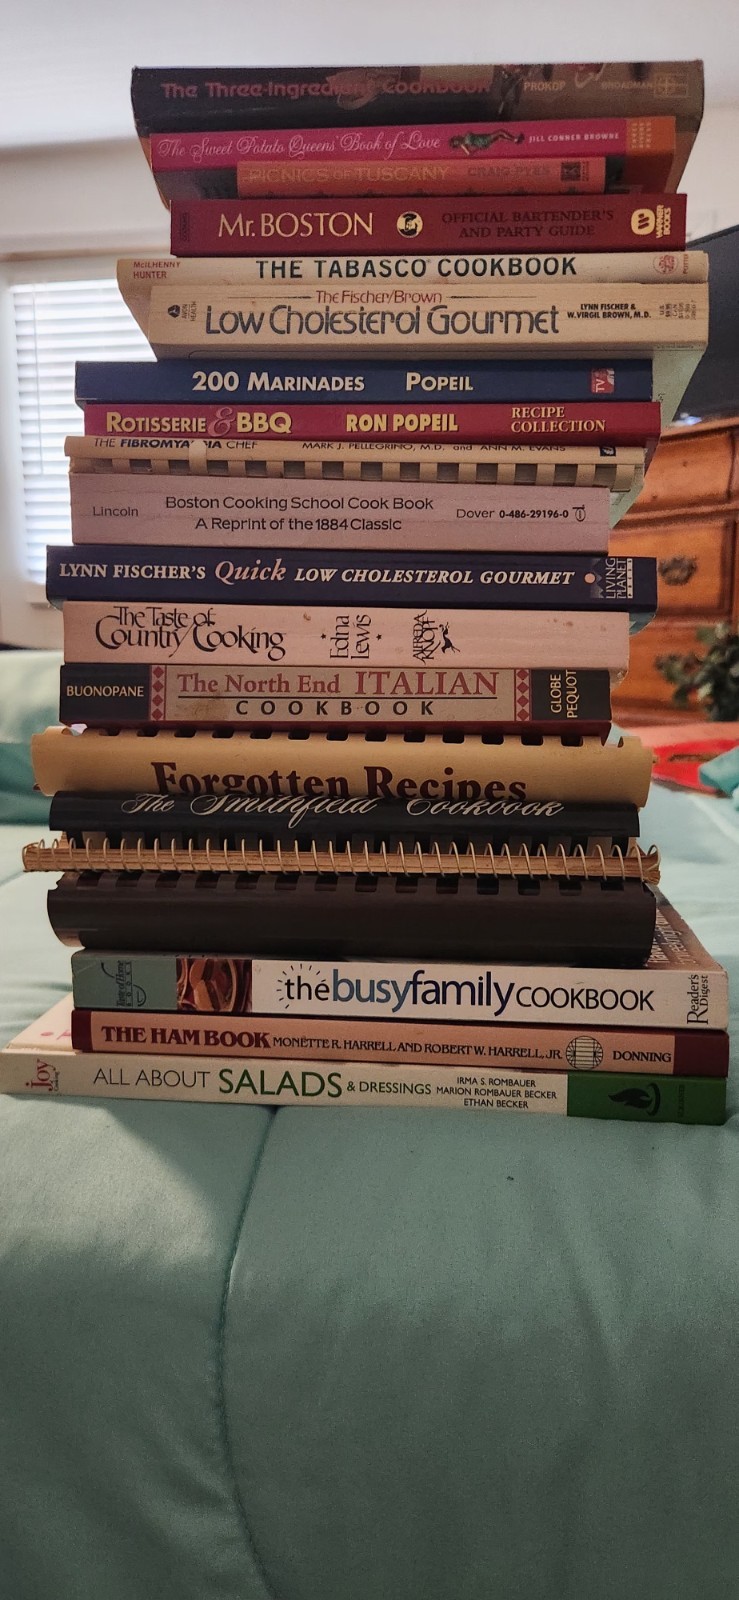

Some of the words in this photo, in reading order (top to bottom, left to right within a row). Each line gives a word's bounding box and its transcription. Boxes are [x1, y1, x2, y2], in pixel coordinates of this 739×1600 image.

[161, 82, 198, 98] The
[523, 80, 566, 91] PROKOP
[157, 138, 185, 157] The
[190, 137, 233, 163] Sweet
[236, 135, 286, 155] Potato
[340, 131, 383, 152] Book
[384, 129, 402, 160] of
[402, 130, 441, 151] Love
[529, 135, 546, 143] JILL
[548, 134, 581, 142] CONNER
[584, 132, 620, 141] BROWNE
[249, 166, 329, 182] PICNICS
[355, 165, 450, 182] TUSCANY
[218, 213, 255, 238] Mr.
[260, 212, 373, 238] BOSTON
[442, 212, 507, 224] OFFICIAL
[513, 210, 614, 223] BARTENDER'S
[656, 204, 665, 239] WARNER
[663, 207, 672, 236] BOOKS
[459, 227, 491, 239] AND
[496, 226, 543, 238] PARTY
[548, 225, 596, 237] GUIDE
[133, 270, 167, 280] HUNTER
[255, 260, 303, 279] THE
[437, 256, 577, 277] COOKBOOK
[316, 290, 340, 304] The
[341, 290, 443, 304] Fischer/Brown
[580, 303, 599, 311] LYNN
[600, 303, 629, 311] FISCHER
[602, 311, 633, 320] BROWN,
[633, 311, 652, 319] M.D.
[206, 306, 266, 335] Low
[268, 304, 421, 335] Cholesterol
[427, 304, 560, 336] Gourmet
[192, 371, 240, 391] 200
[406, 371, 474, 391] POPEIL
[595, 378, 606, 393] TV
[106, 411, 206, 433] ROTISSERIE
[207, 407, 236, 437] &
[236, 412, 293, 434] BBQ
[511, 406, 565, 419] RECIPE
[346, 413, 387, 432] RON
[393, 413, 459, 432] POPEIL
[510, 419, 606, 433] COLLECTION
[94, 437, 116, 448] THE
[120, 438, 222, 449] FIBROMYAIA
[226, 440, 258, 450] CHEF
[302, 442, 334, 450] MARK
[337, 442, 344, 450] J.
[348, 442, 417, 452] PELLEGRINO,
[420, 443, 445, 451] M.D.
[480, 444, 508, 452] ANN
[92, 506, 139, 518] Lincoln
[166, 496, 220, 510] Boston
[223, 497, 287, 511] Cooking
[290, 497, 344, 510] School
[347, 497, 389, 510] Cook
[393, 497, 434, 510] Book
[456, 508, 496, 519] Dover
[499, 509, 569, 519] 0-486-29196-0
[195, 518, 208, 530] A
[211, 518, 267, 532] Reprint
[269, 518, 285, 530] of
[288, 518, 314, 530] the
[316, 519, 348, 531] 1884
[350, 518, 402, 531] Classic
[59, 563, 107, 578] LYNN
[113, 564, 206, 580] FISCHER'S
[214, 558, 287, 586] Quick
[294, 568, 338, 582] LOW
[341, 568, 474, 584] CHOLESTEROL
[479, 570, 576, 586] GOURMET
[605, 557, 616, 599] LIVING
[616, 557, 627, 600] PLANET
[113, 606, 146, 628] The
[147, 606, 190, 628] Taste
[192, 607, 217, 627] of
[95, 615, 193, 658] Country
[193, 622, 287, 662] Cooking
[329, 614, 350, 660] Edna
[351, 614, 372, 660] Lewis
[66, 685, 144, 697] BUONOPANE
[177, 673, 219, 694] The
[225, 674, 290, 694] North
[298, 675, 341, 694] End
[355, 671, 500, 696] ITALIAN
[550, 673, 562, 713] GLOBE
[566, 669, 580, 719] PEQUOT
[236, 700, 434, 716] COOKBOOK
[151, 761, 349, 798] Forgotten
[363, 766, 527, 801] Recipes
[121, 792, 174, 815] The
[516, 986, 655, 1012] COOKBOOK
[686, 974, 705, 1025] Reader's
[700, 975, 710, 1011] Digest
[101, 1026, 146, 1043] THE
[151, 1027, 201, 1045] HAM
[204, 1030, 271, 1049] BOOK
[344, 1040, 396, 1051] HARRELL
[397, 1042, 423, 1053] AND
[424, 1043, 473, 1055] ROBERT
[474, 1045, 486, 1056] W.
[488, 1046, 544, 1060] HARRELL,
[612, 1050, 672, 1063] DONNING
[93, 1067, 131, 1086] ALL
[135, 1069, 211, 1089] ABOUT
[218, 1068, 343, 1098] SALADS
[347, 1081, 356, 1092] &
[359, 1081, 432, 1095] DRESSINGS
[456, 1077, 479, 1087] IRMA
[480, 1077, 487, 1087] S.
[488, 1077, 536, 1088] ROMBAUER
[436, 1086, 472, 1096] MARION
[474, 1087, 523, 1098] ROMBAUER
[524, 1089, 557, 1100] BECKER
[463, 1098, 494, 1108] ETHAN
[496, 1099, 529, 1109] BECKER
